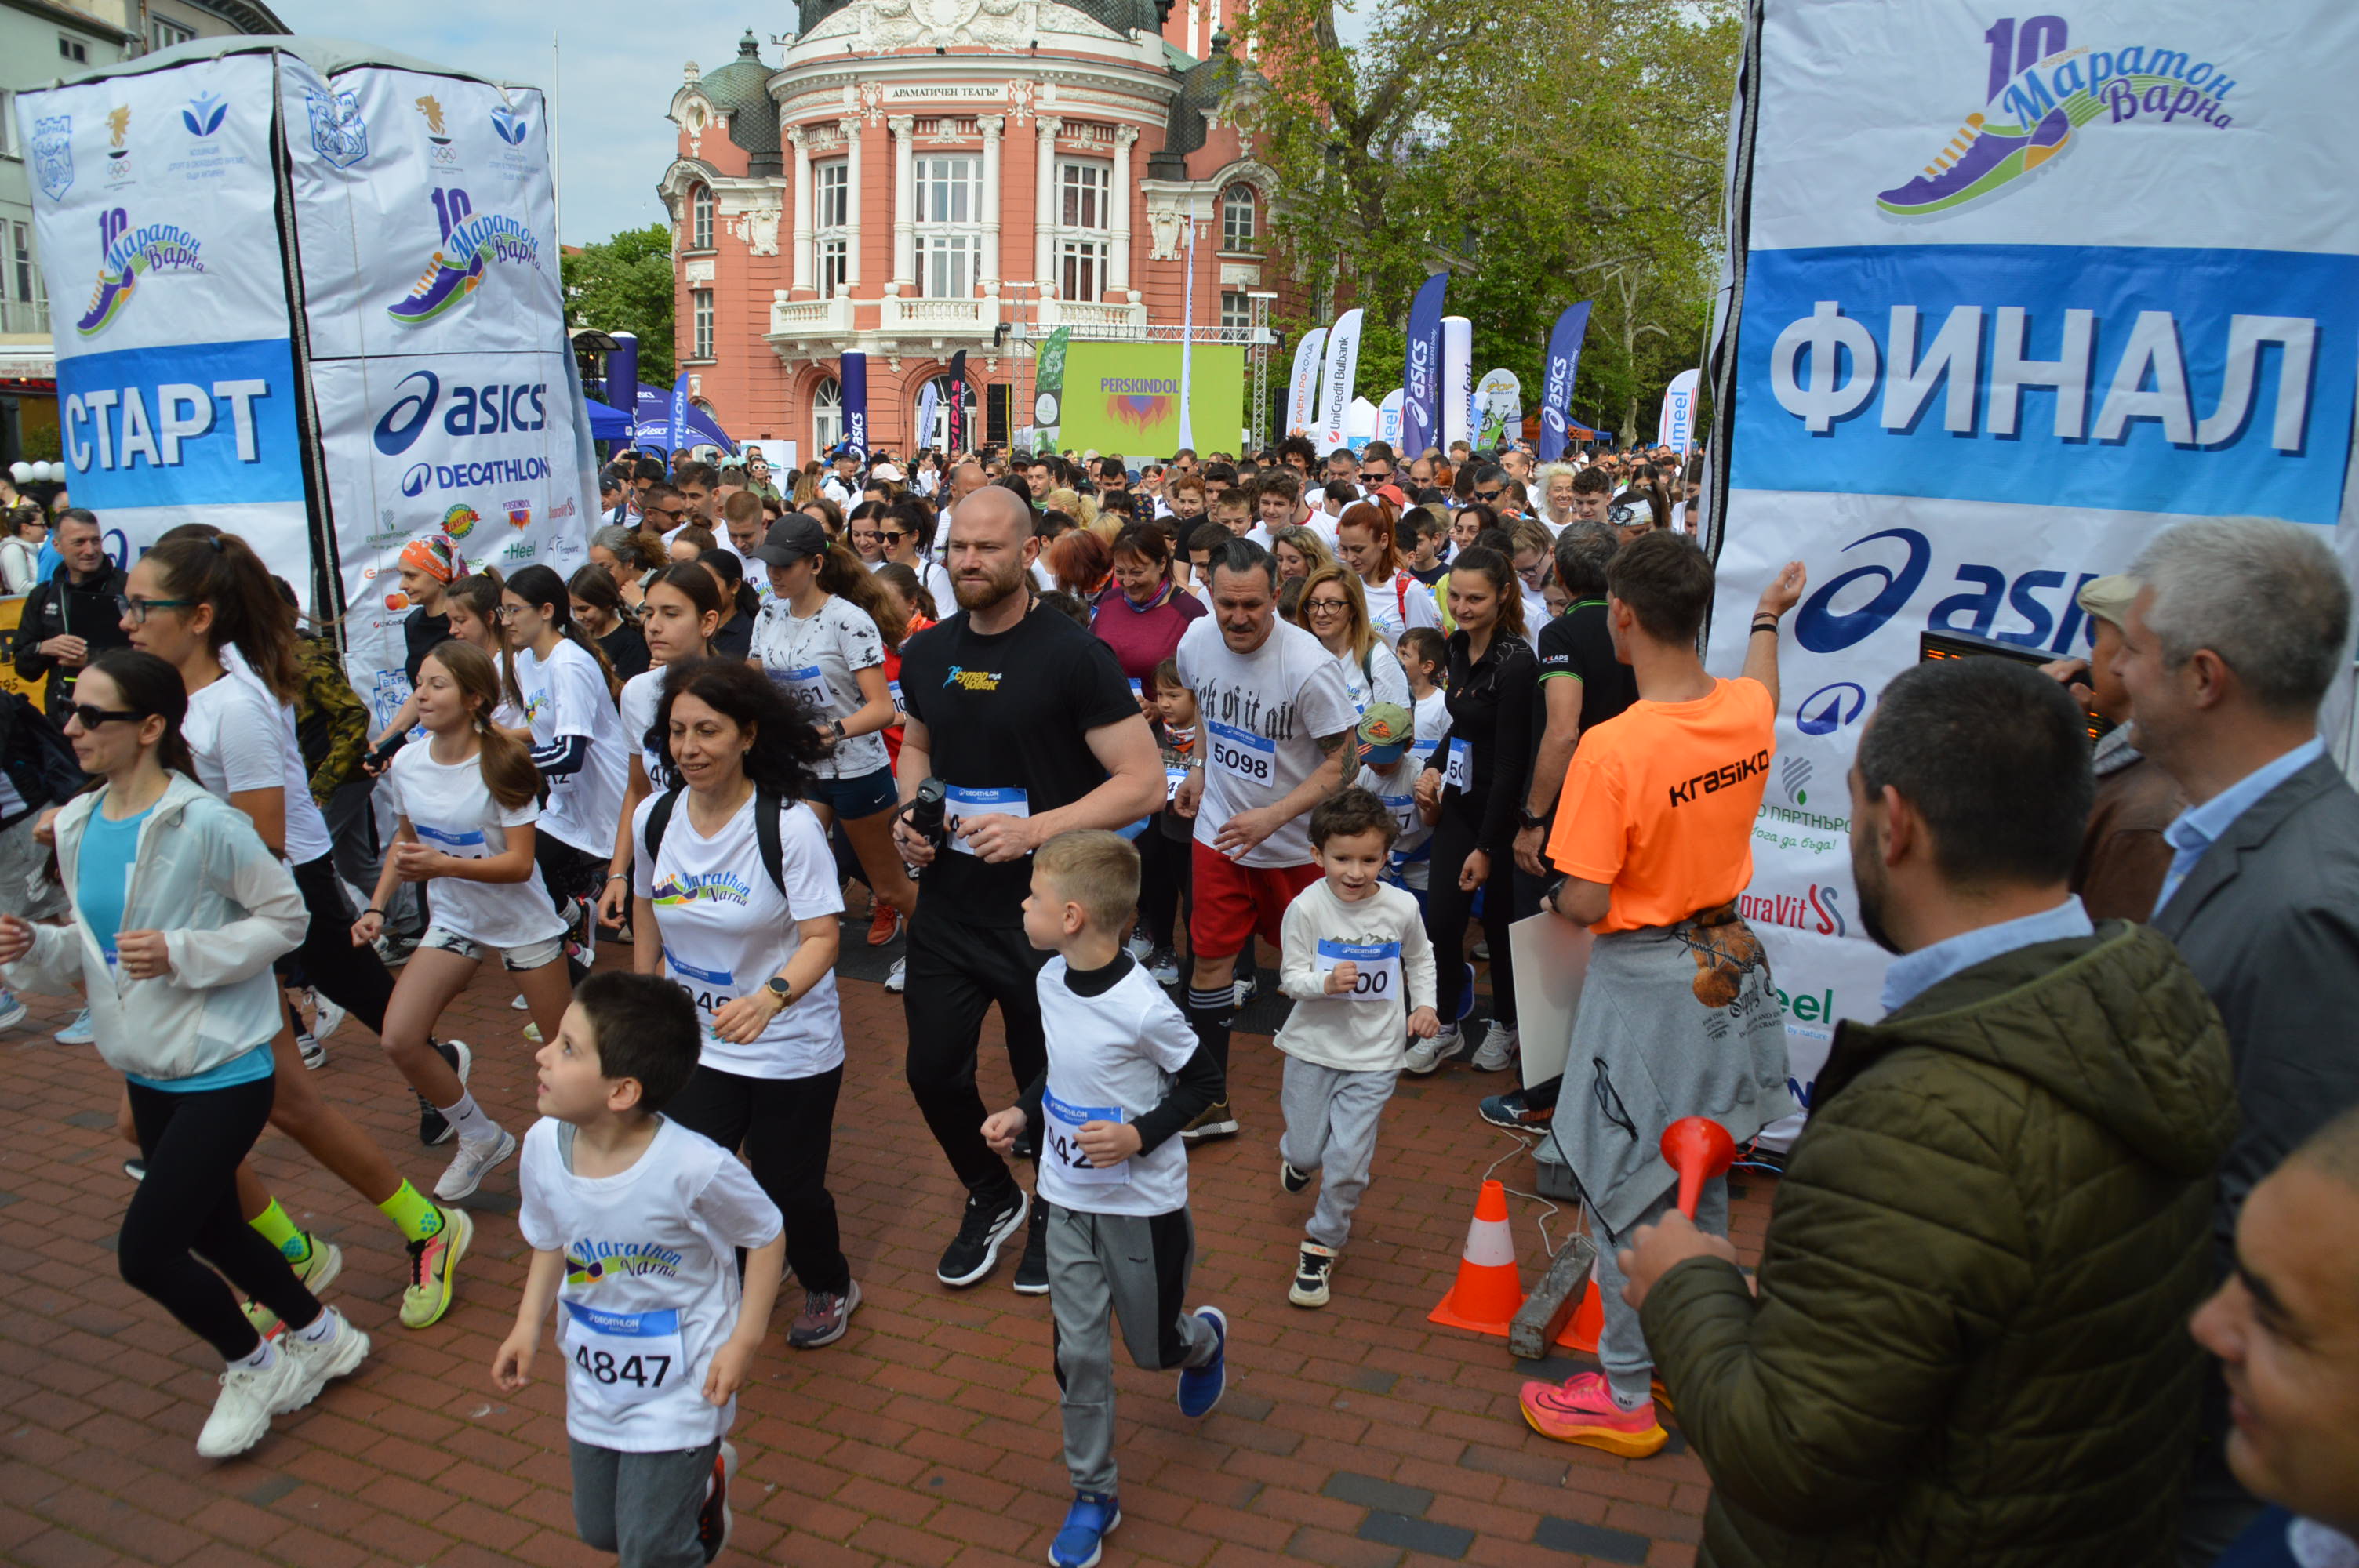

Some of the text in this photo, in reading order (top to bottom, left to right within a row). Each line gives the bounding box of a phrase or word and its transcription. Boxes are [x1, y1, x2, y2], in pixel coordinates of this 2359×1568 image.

[1985, 15, 2068, 107] 10
[892, 87, 998, 98] ДРАМАТИЧЕН ТЕАТЪР
[2003, 45, 2237, 132] Маратон
[2099, 78, 2233, 129] Варна
[99, 208, 127, 265] 10
[431, 187, 472, 248] 10
[108, 223, 201, 276] Маратон
[145, 244, 204, 272] Варна
[450, 214, 539, 266] Маратон
[492, 234, 541, 270] Варна
[1100, 377, 1179, 394] PERSKINDOL
[1330, 336, 1349, 430] UniCredit Bulbank
[1411, 338, 1427, 398] asics
[1549, 356, 1567, 408] asics
[1770, 301, 2318, 453] ФИНАЛ
[66, 379, 269, 473] СТАРТ
[444, 383, 547, 436] asics
[675, 390, 684, 448] ATHLON
[851, 412, 863, 445] asics
[1671, 391, 1688, 453] umeel
[436, 456, 551, 489] DECATHLON
[510, 541, 536, 559] Heel
[1928, 564, 2100, 655] asi
[1245, 690, 1260, 731] it
[1214, 742, 1268, 779] 5098
[1779, 836, 1797, 849] да
[682, 871, 751, 897] Marathon
[707, 886, 747, 907] Varna
[1776, 989, 1834, 1024] eel
[1787, 1025, 1828, 1040] by nature
[573, 1237, 682, 1267] Marathon
[620, 1257, 677, 1279] Varna
[594, 1316, 639, 1327] DECATHLON
[576, 1344, 671, 1388] 4847
